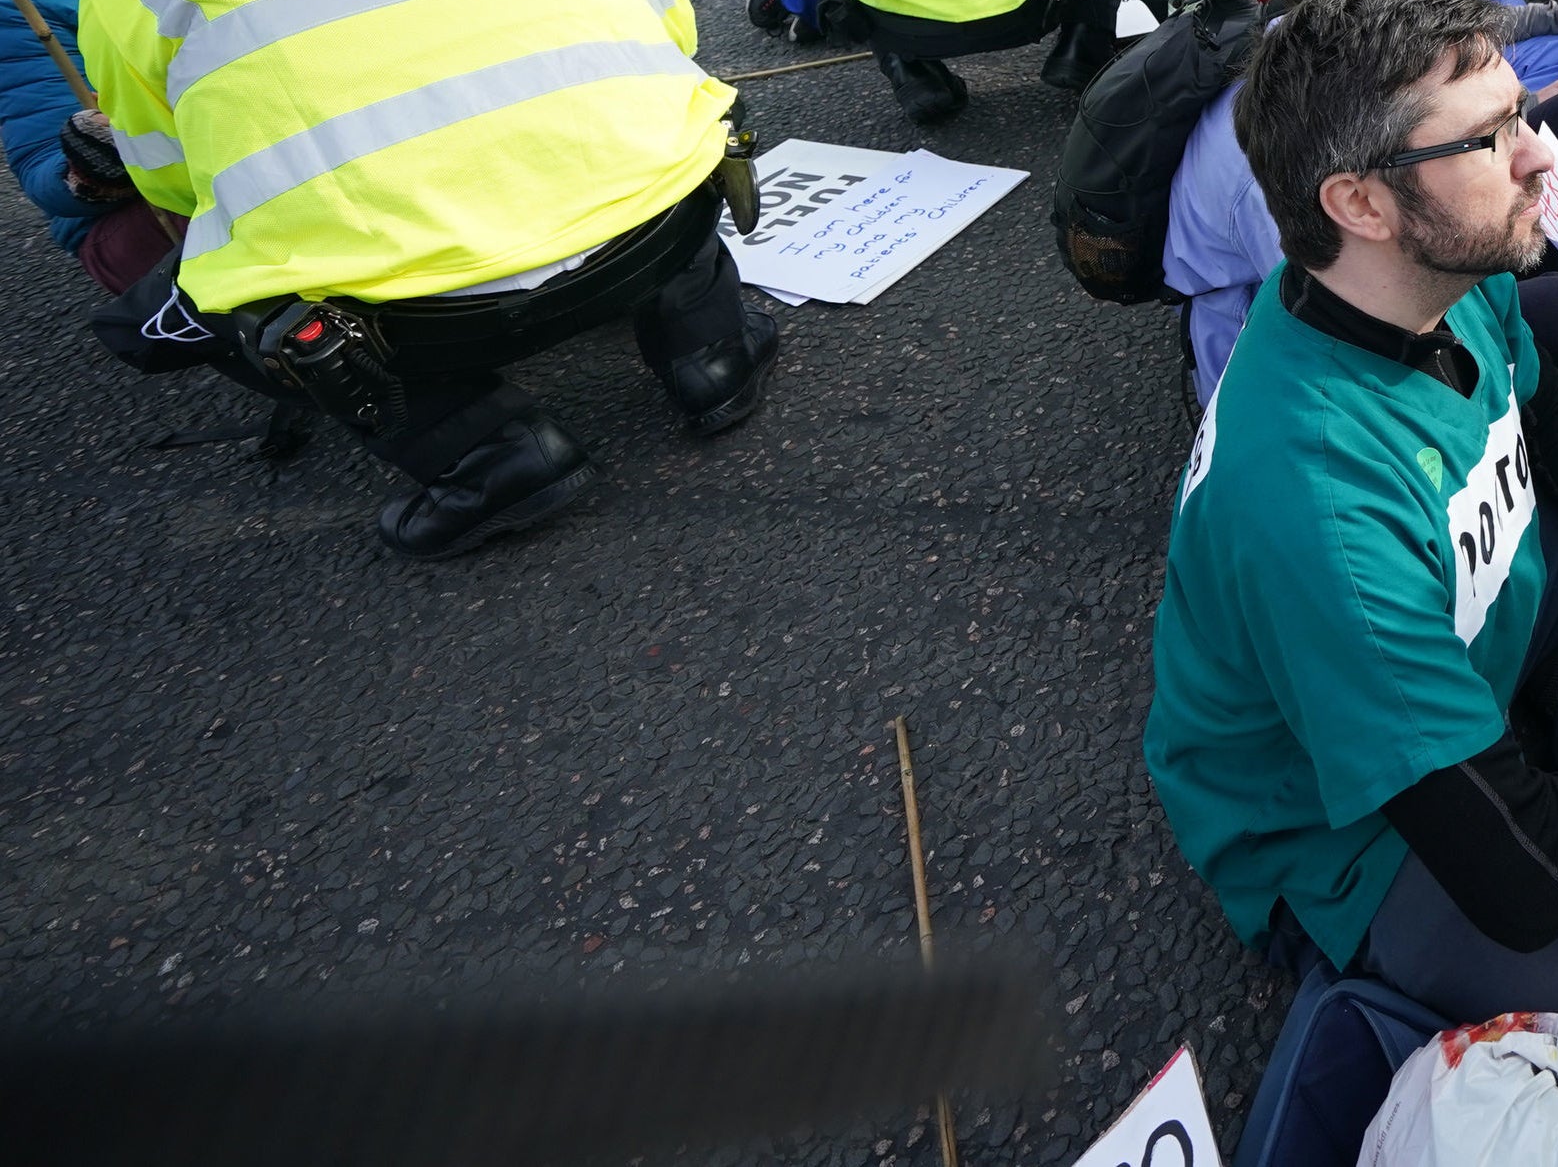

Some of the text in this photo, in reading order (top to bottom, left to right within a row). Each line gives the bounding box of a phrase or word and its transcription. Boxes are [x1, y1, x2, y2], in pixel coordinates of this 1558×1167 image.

[779, 170, 913, 255] I am here for
[853, 208, 927, 255] and my
[813, 242, 847, 260] my
